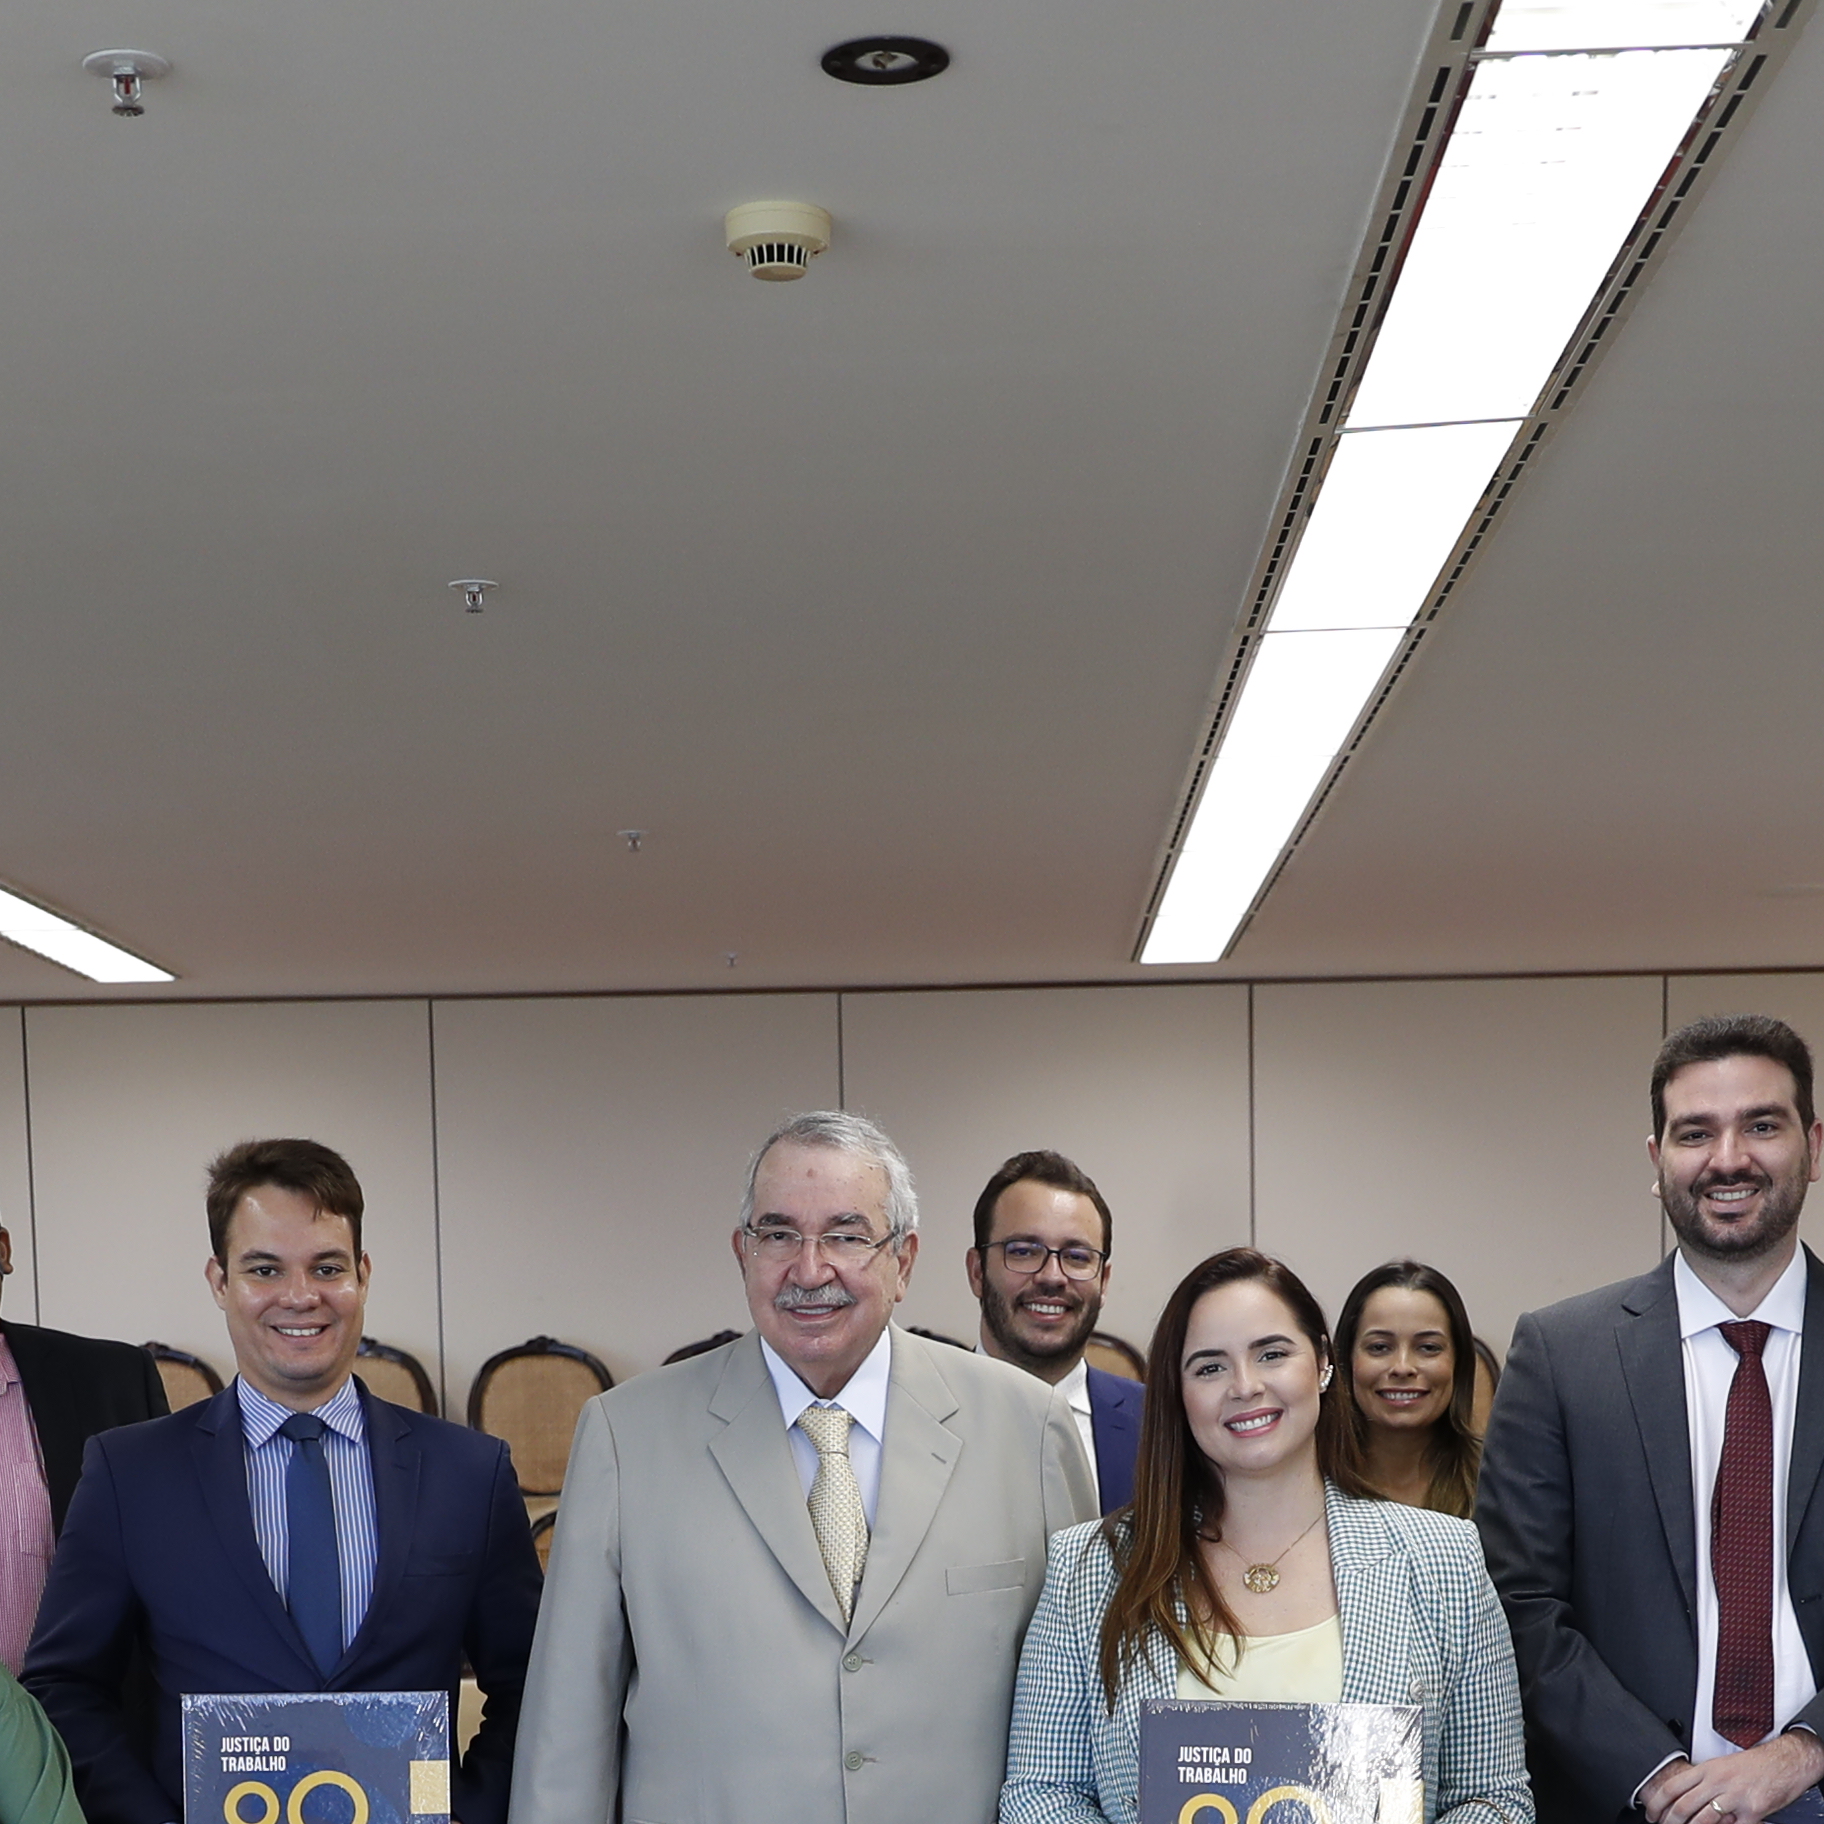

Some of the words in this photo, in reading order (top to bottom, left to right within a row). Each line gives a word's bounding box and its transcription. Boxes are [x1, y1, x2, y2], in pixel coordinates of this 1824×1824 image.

[220, 1736, 270, 1755] JUSTIÇA
[273, 1736, 290, 1752] DO
[220, 1755, 286, 1772] TRABALHO
[1177, 1746, 1231, 1766] JUSTIÇA
[1234, 1747, 1252, 1764] DO
[1177, 1766, 1247, 1785] TRABALHO
